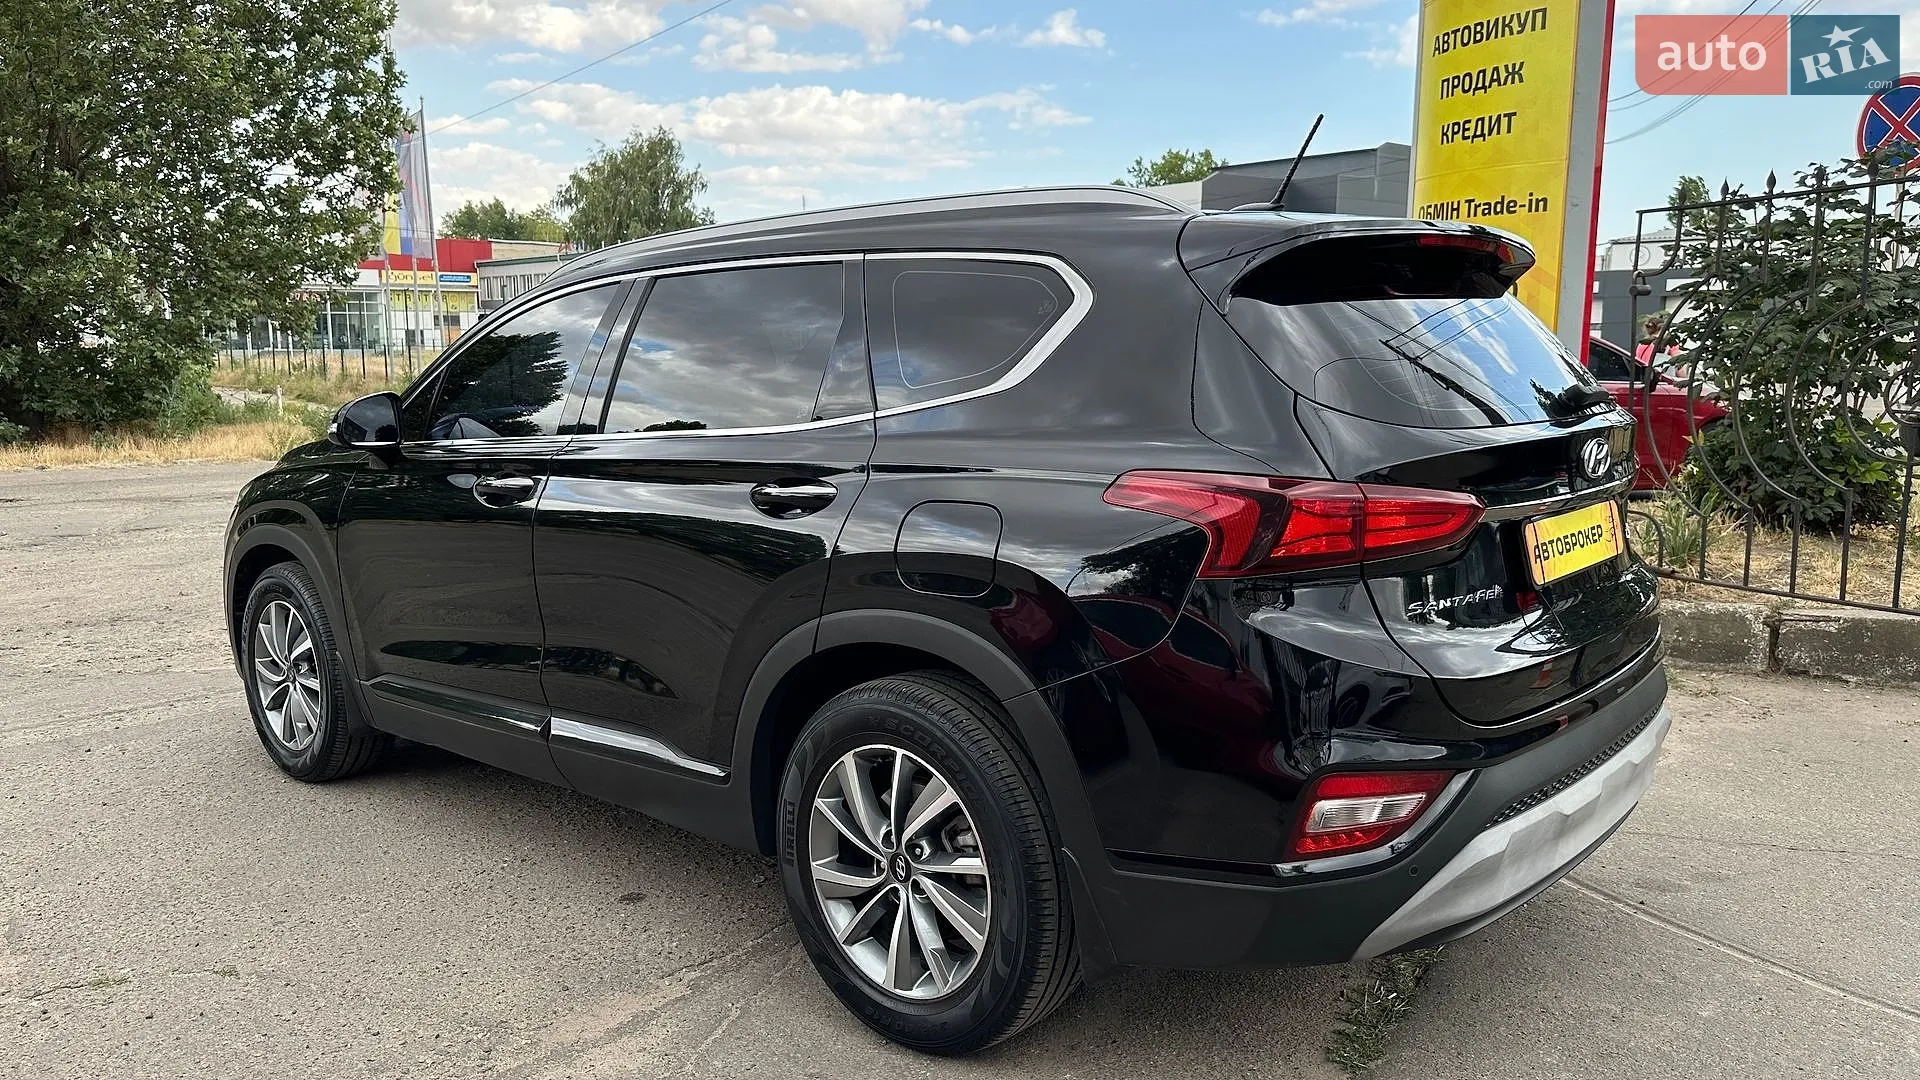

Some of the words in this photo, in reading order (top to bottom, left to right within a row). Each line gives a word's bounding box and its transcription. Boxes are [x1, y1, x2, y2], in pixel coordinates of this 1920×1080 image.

[1432, 7, 1548, 58] АВТОВИКУП
[1440, 61, 1525, 100] ПРОДАЖ
[1440, 111, 1517, 145] КРЕДИТ
[1464, 192, 1548, 218] Trade-in
[1534, 524, 1603, 564] АВТОБРОКЕР
